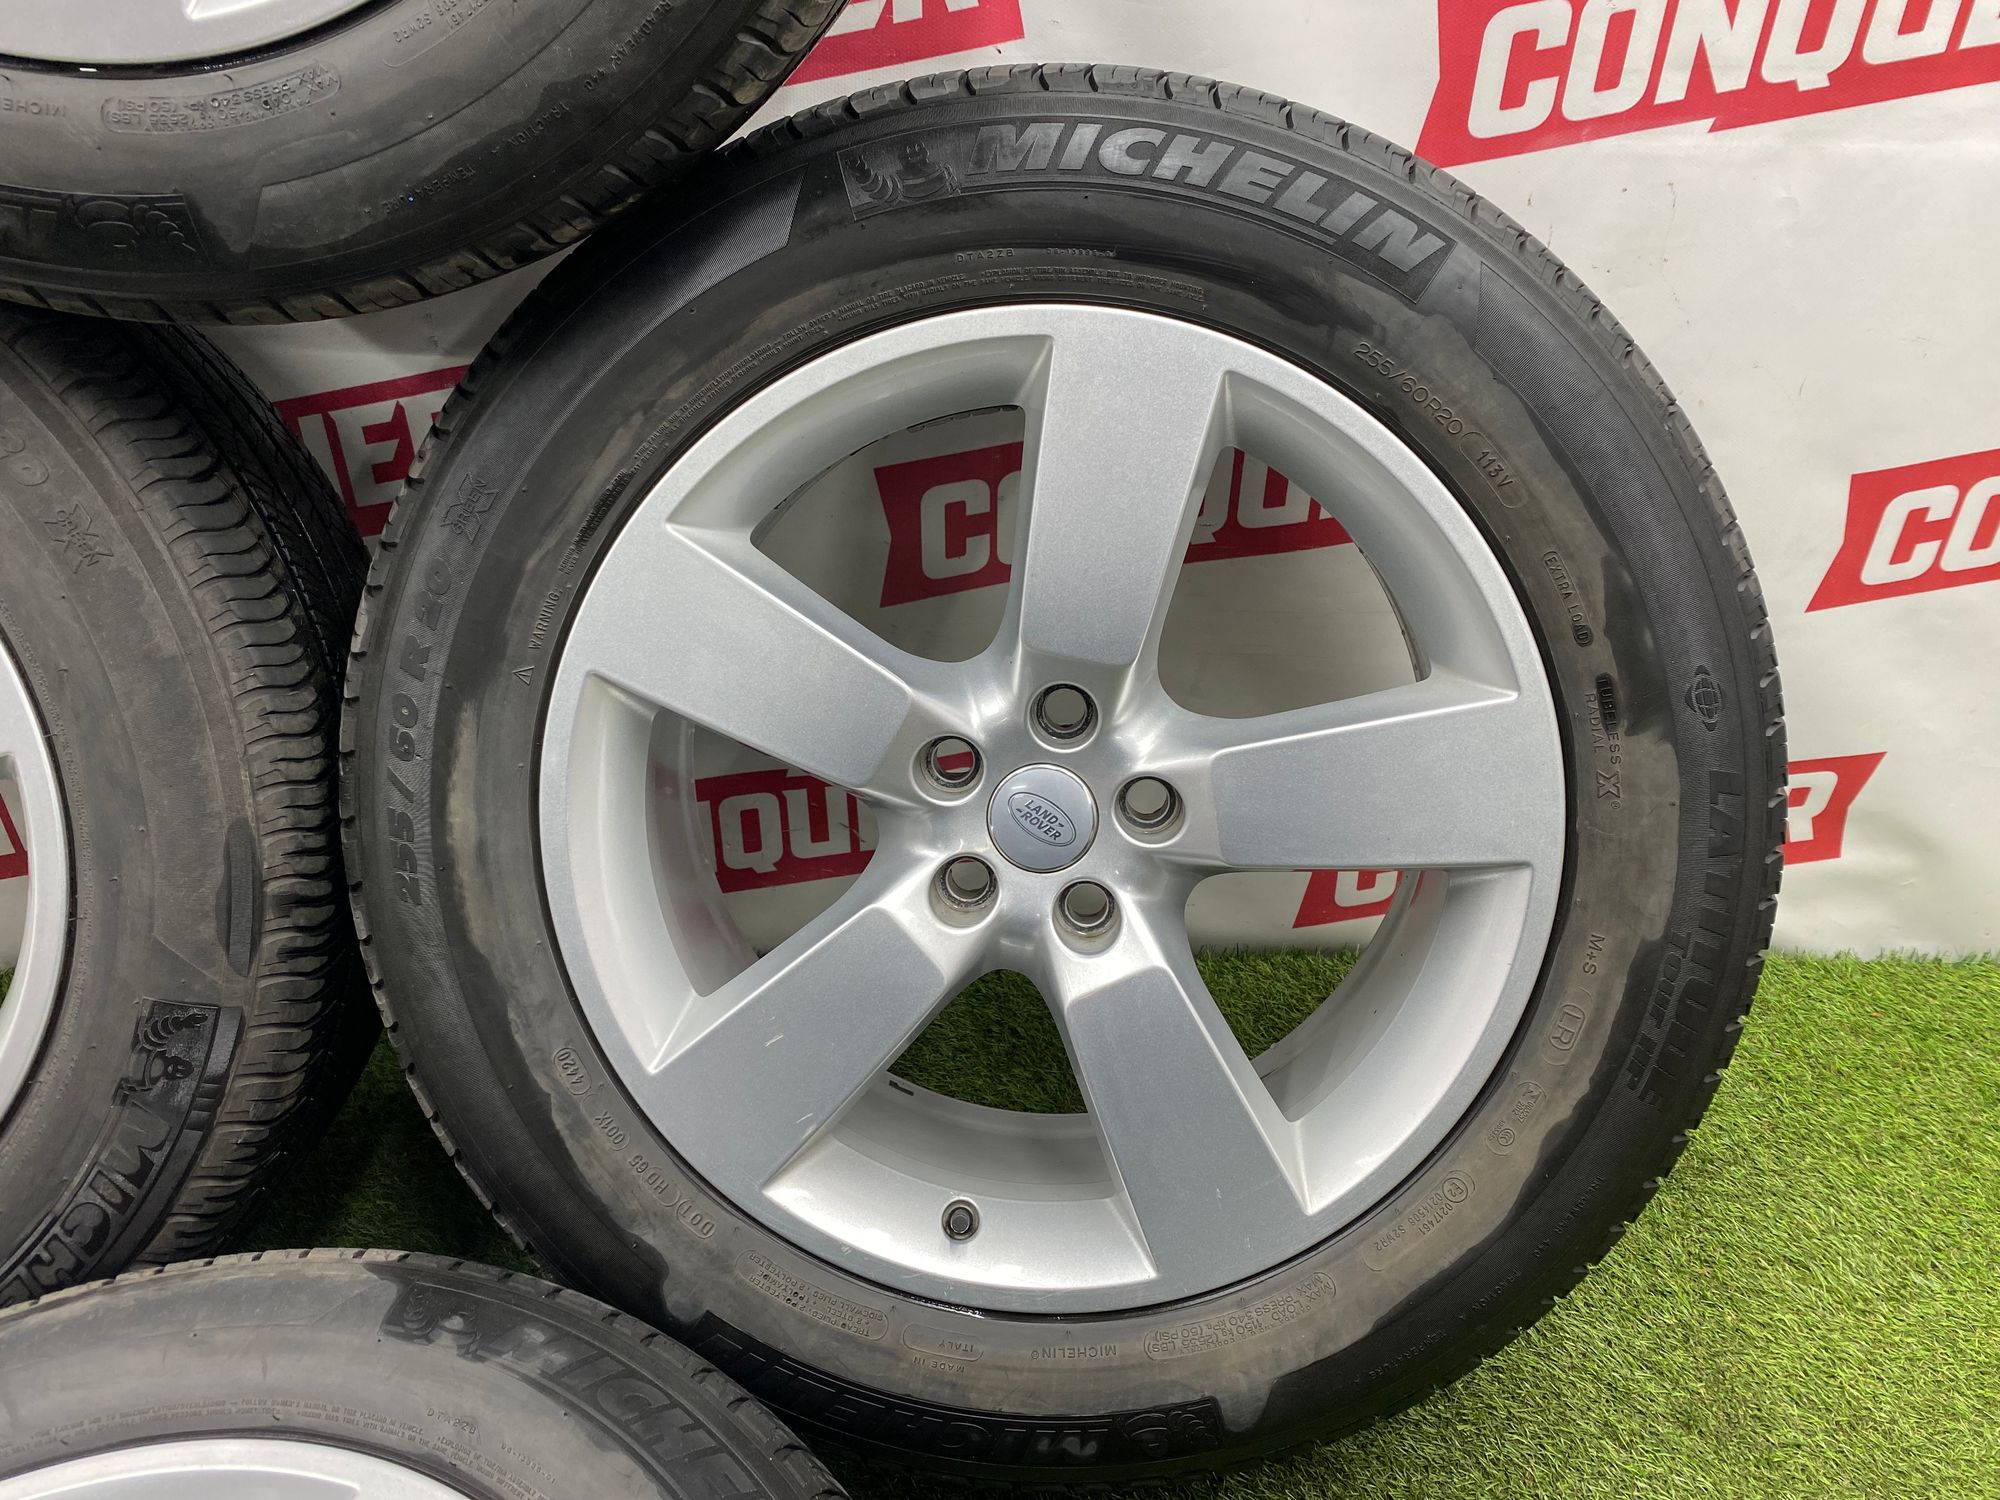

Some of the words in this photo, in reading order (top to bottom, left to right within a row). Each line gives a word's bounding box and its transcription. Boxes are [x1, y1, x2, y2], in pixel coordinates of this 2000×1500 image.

[966, 121, 1450, 278] MICHELIN
[1350, 337, 1468, 439] 255/60R20
[1472, 446, 1515, 492] 113V
[1542, 553, 1575, 601] EXTRA
[1565, 603, 1592, 643] LOAD
[1583, 691, 1606, 753] RADIAL
[1594, 675, 1623, 766] TUBELESS
[1579, 933, 1607, 976] M+S
[1550, 1008, 1582, 1048] LR
[554, 1049, 586, 1088] 4420
[592, 1109, 627, 1147] 001X
[676, 1201, 716, 1238] DOT
[1416, 1200, 1454, 1236] 0217461
[1372, 1222, 1408, 1252] S2WR2
[1294, 1273, 1324, 1296] MAX
[1303, 1280, 1334, 1304] MAX
[1226, 1308, 1255, 1328] 340
[1252, 1291, 1295, 1317] PRESS
[1268, 1298, 1304, 1323] LOAD
[839, 1319, 871, 1338] TREAD
[1234, 1316, 1263, 1335] 1150
[936, 1337, 975, 1353] ITALY
[928, 1358, 965, 1374] MADE
